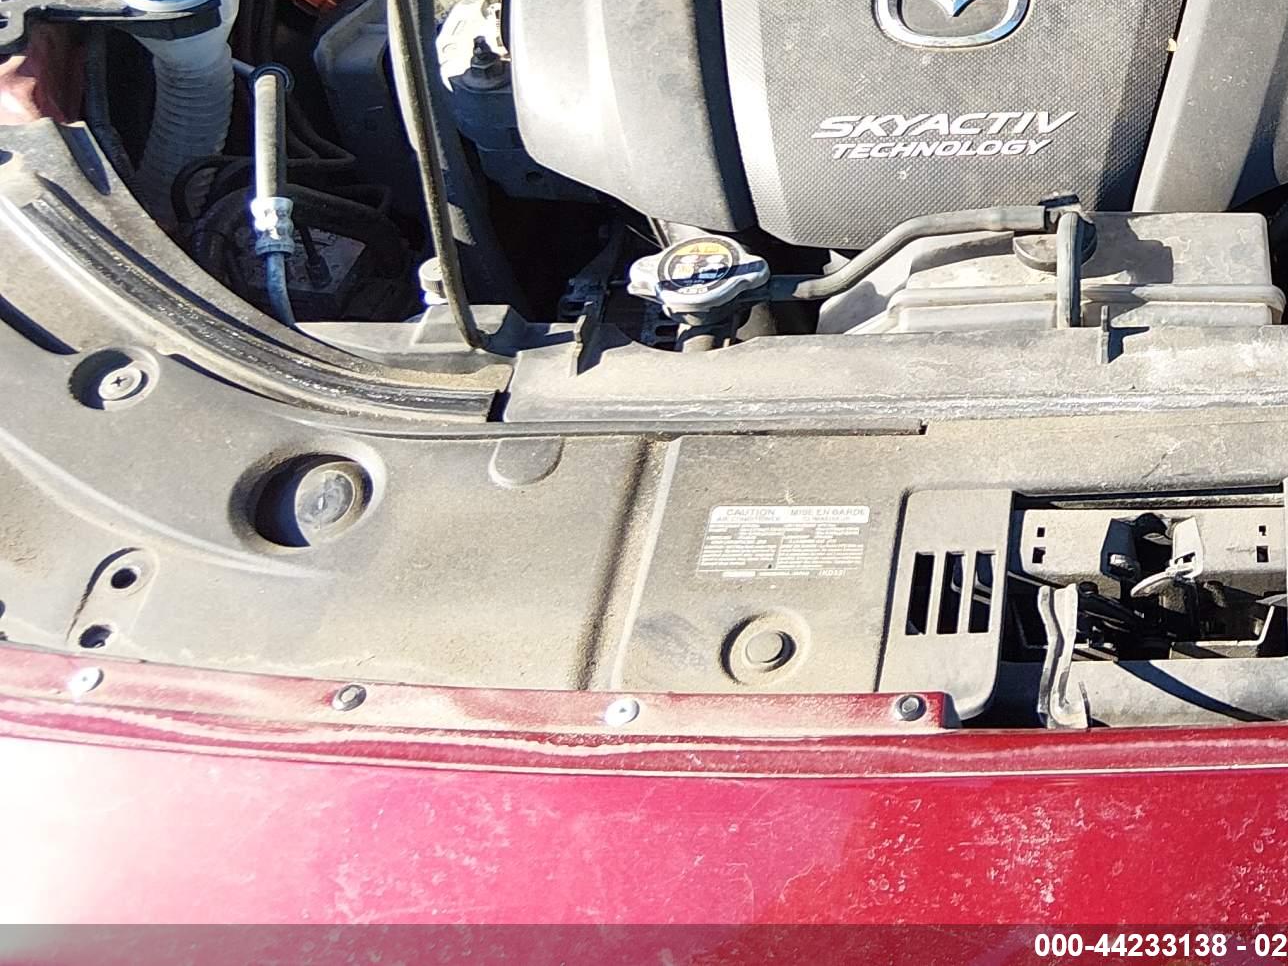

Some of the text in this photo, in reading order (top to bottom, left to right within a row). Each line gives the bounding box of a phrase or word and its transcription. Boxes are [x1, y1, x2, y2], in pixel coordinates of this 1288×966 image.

[811, 111, 1078, 139] SKYACTIV
[832, 139, 1054, 160] TECHNOLOGY
[726, 508, 776, 516] CAUTION
